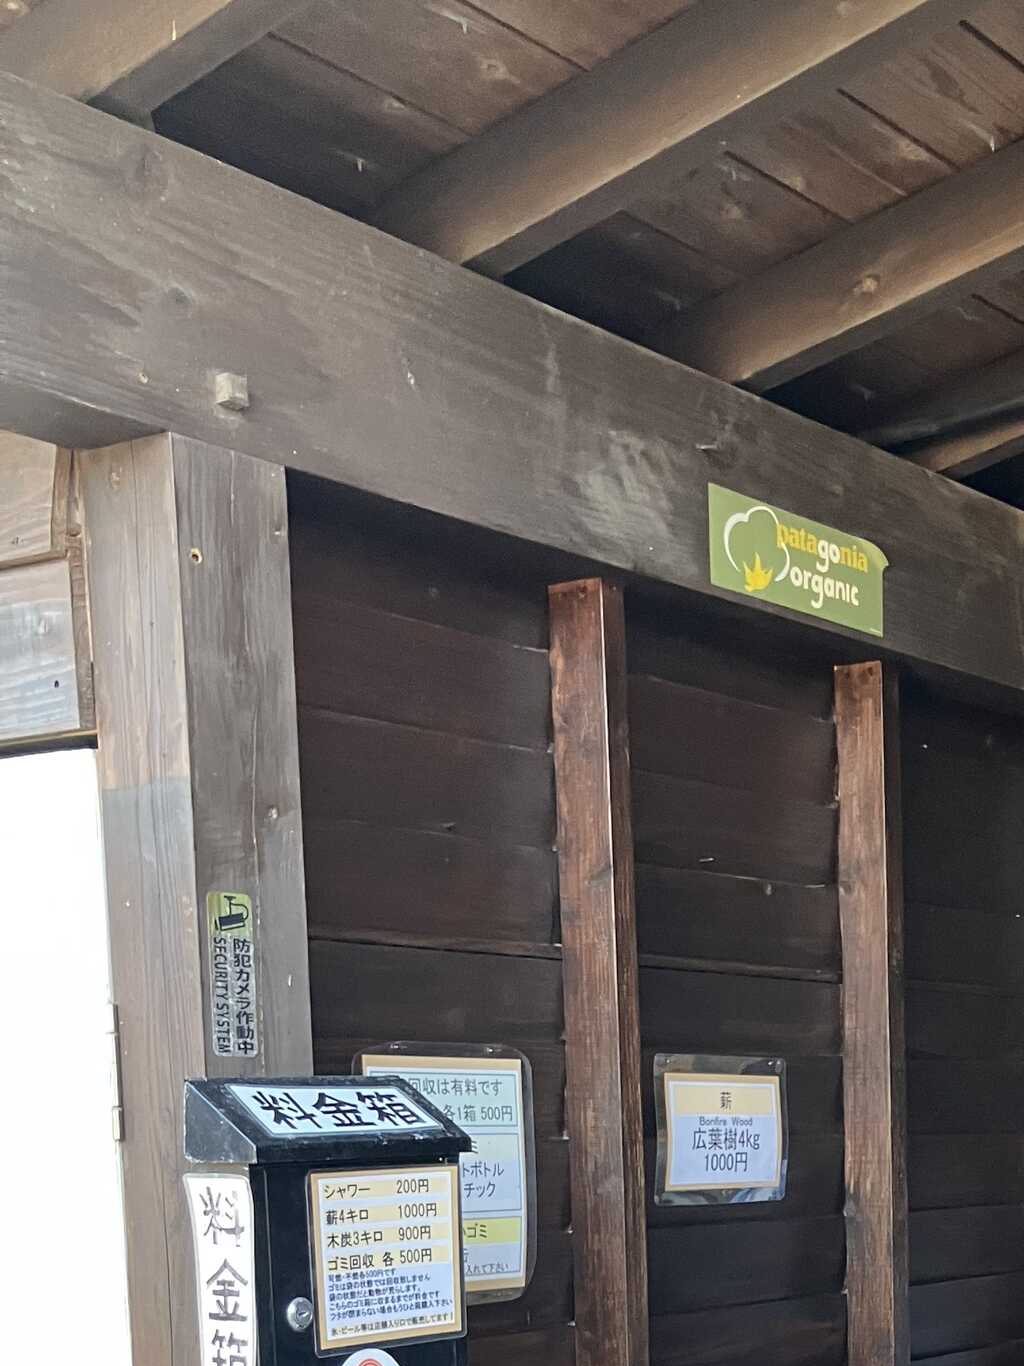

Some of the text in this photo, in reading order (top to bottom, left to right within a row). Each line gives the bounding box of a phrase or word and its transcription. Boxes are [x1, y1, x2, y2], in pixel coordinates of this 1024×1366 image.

[776, 523, 868, 573] patagonia
[789, 566, 860, 609] organic
[213, 937, 229, 1000] SECURITY
[233, 938, 255, 1054] 防犯カメラ作動中
[409, 1077, 503, 1097] 回収は有料です
[252, 1091, 427, 1129] 料金箱
[481, 1105, 513, 1122] 500円
[699, 1116, 753, 1126] Bonfire Wood
[692, 1128, 760, 1151] 広葉樹4kg
[463, 1162, 504, 1177] トボトル
[705, 1152, 748, 1172] 1000円
[323, 1179, 429, 1199] シャワー 200円
[464, 1182, 496, 1198] チック
[325, 1203, 437, 1226] 薪4キロ 1000円
[327, 1225, 431, 1248] 木炭3キロ 900円
[327, 1248, 432, 1271] ゴミ回収 各 500円
